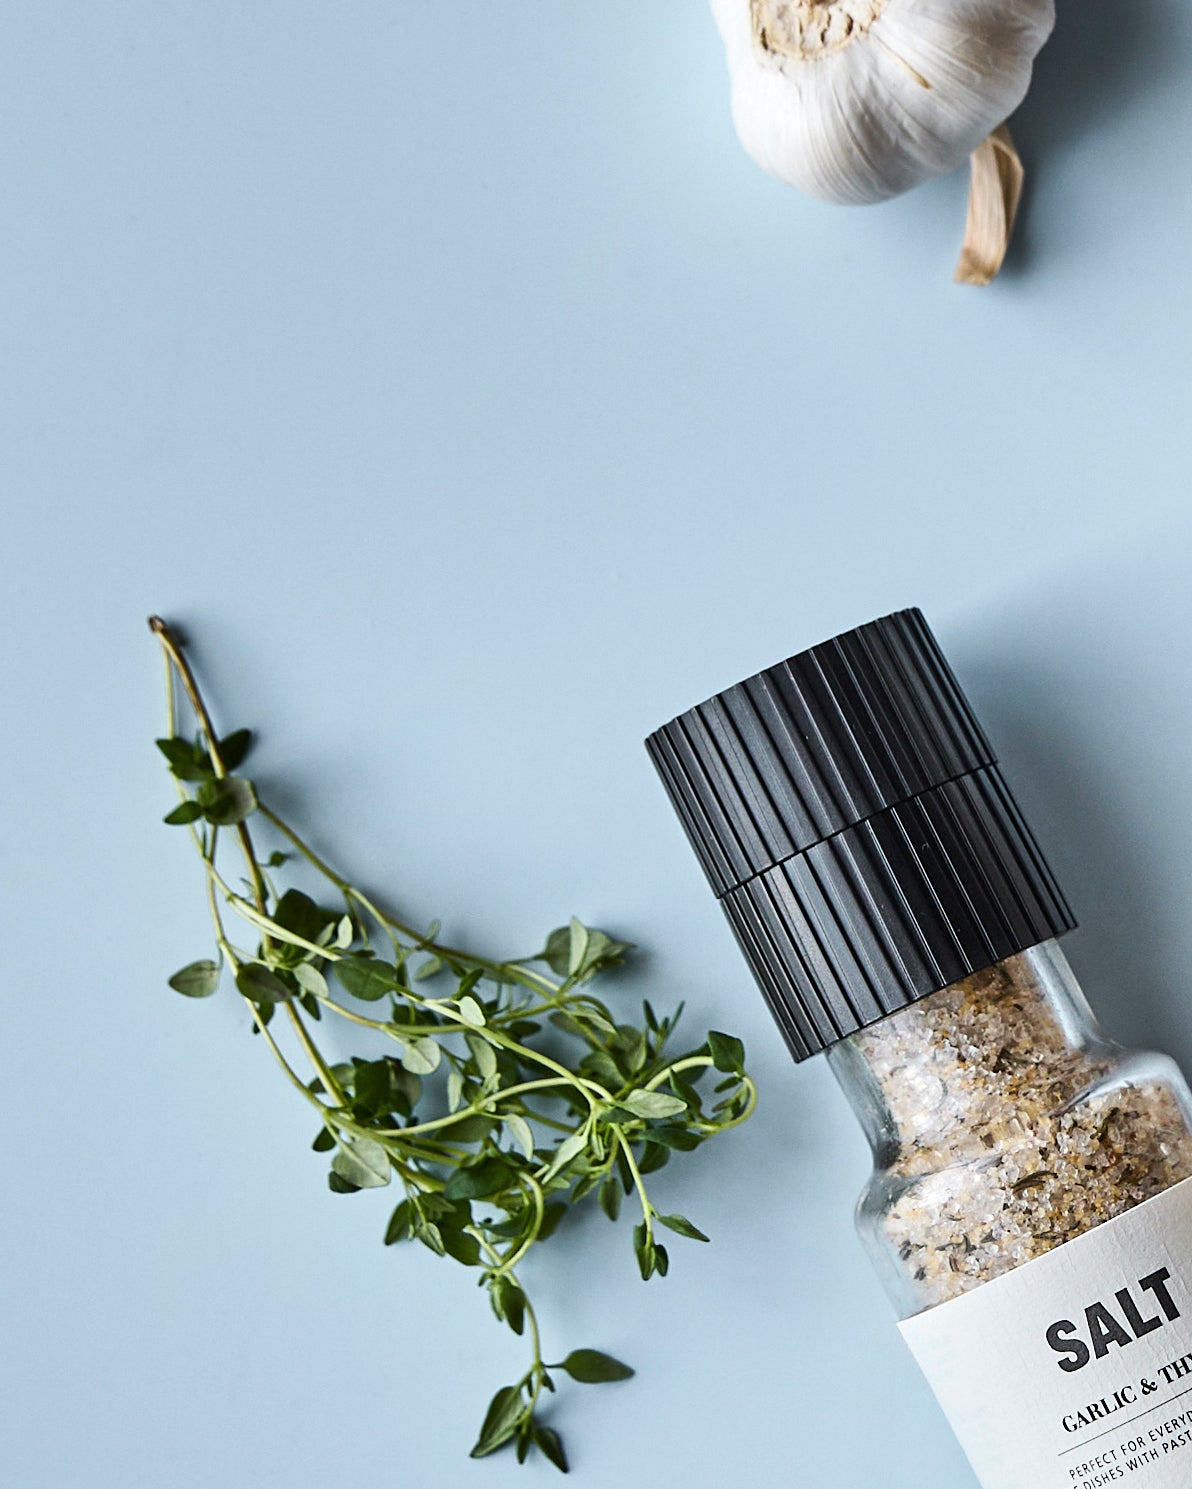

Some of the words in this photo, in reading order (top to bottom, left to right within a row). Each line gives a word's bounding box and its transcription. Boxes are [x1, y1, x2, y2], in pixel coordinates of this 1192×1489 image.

[1046, 1266, 1181, 1373] SALT
[1063, 1386, 1137, 1432] GARLIC
[1141, 1378, 1158, 1395] &
[1068, 1449, 1117, 1480] PERFECT
[1121, 1437, 1146, 1455] FOR
[1126, 1448, 1159, 1471] WITH
